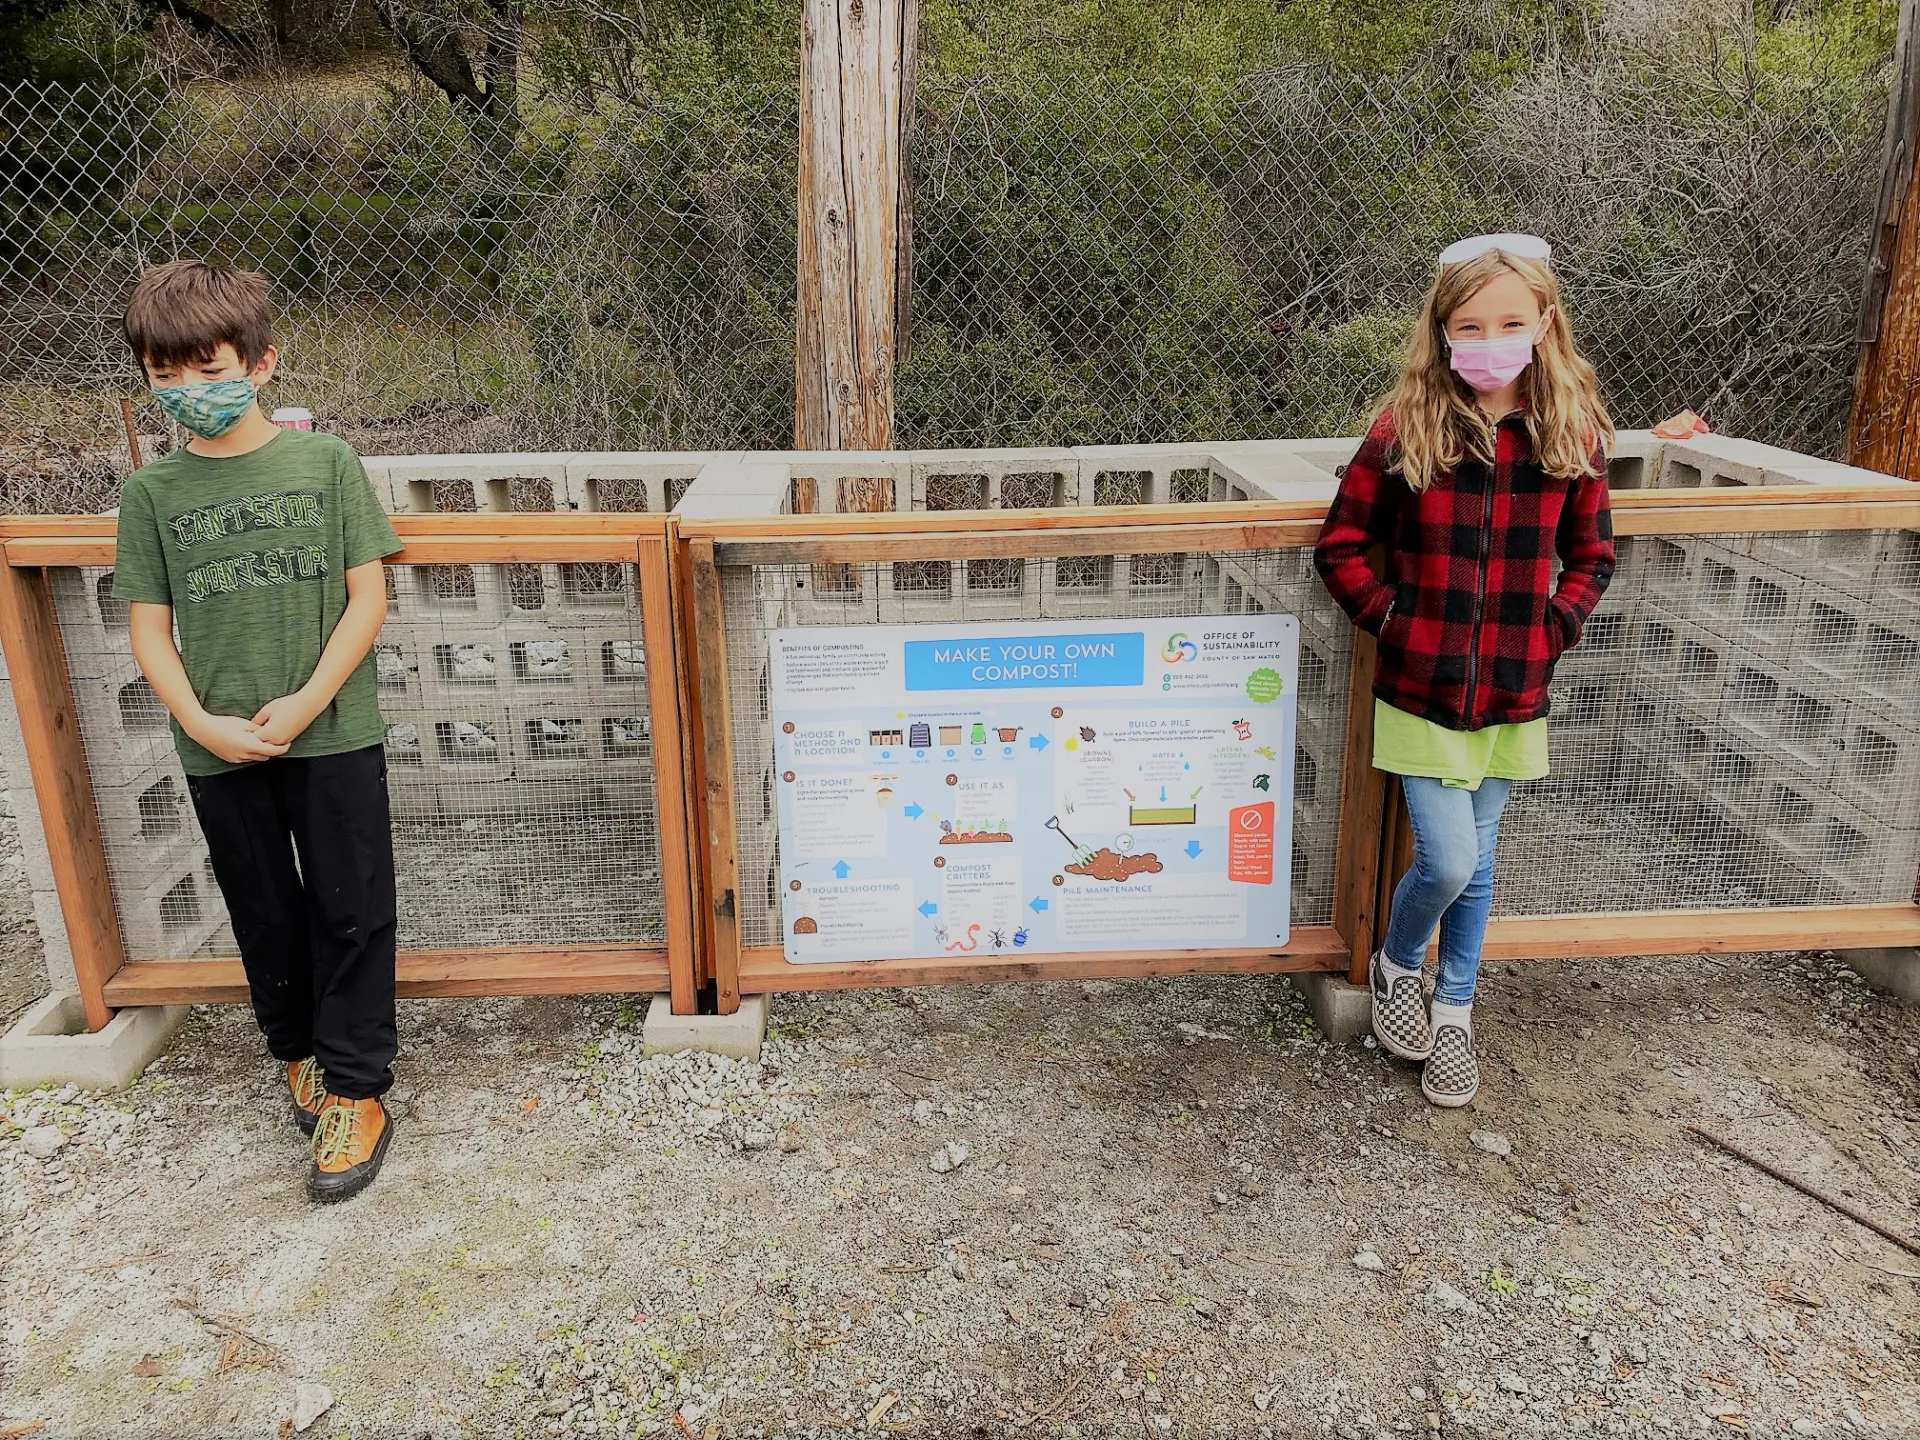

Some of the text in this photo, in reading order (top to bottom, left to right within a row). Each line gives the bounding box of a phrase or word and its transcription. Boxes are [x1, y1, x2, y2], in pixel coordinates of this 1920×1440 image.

[176, 495, 318, 545] CAN'T STOP
[189, 550, 324, 598] WON'T STOP
[1203, 631, 1255, 640] OFFICE OF
[1203, 641, 1280, 650] SUSTAINABILITY
[934, 643, 1115, 663] MAKE YOUR OWN
[972, 662, 1078, 681] COMPOST!
[1128, 720, 1157, 728] BUILD
[1170, 719, 1191, 727] PILE
[793, 731, 834, 739] CHOOSE
[794, 738, 861, 748] METHOD AND
[805, 747, 856, 755] LOCATION
[786, 772, 792, 780] 6
[796, 780, 805, 788] IS
[820, 778, 853, 787] DONE?
[980, 782, 989, 790] IT
[946, 864, 991, 872] COMPOST
[946, 872, 991, 880] CRITTERS
[806, 884, 900, 895] TROUBLESHOOTING
[1063, 885, 1153, 895] PILE MAINTENANCE
